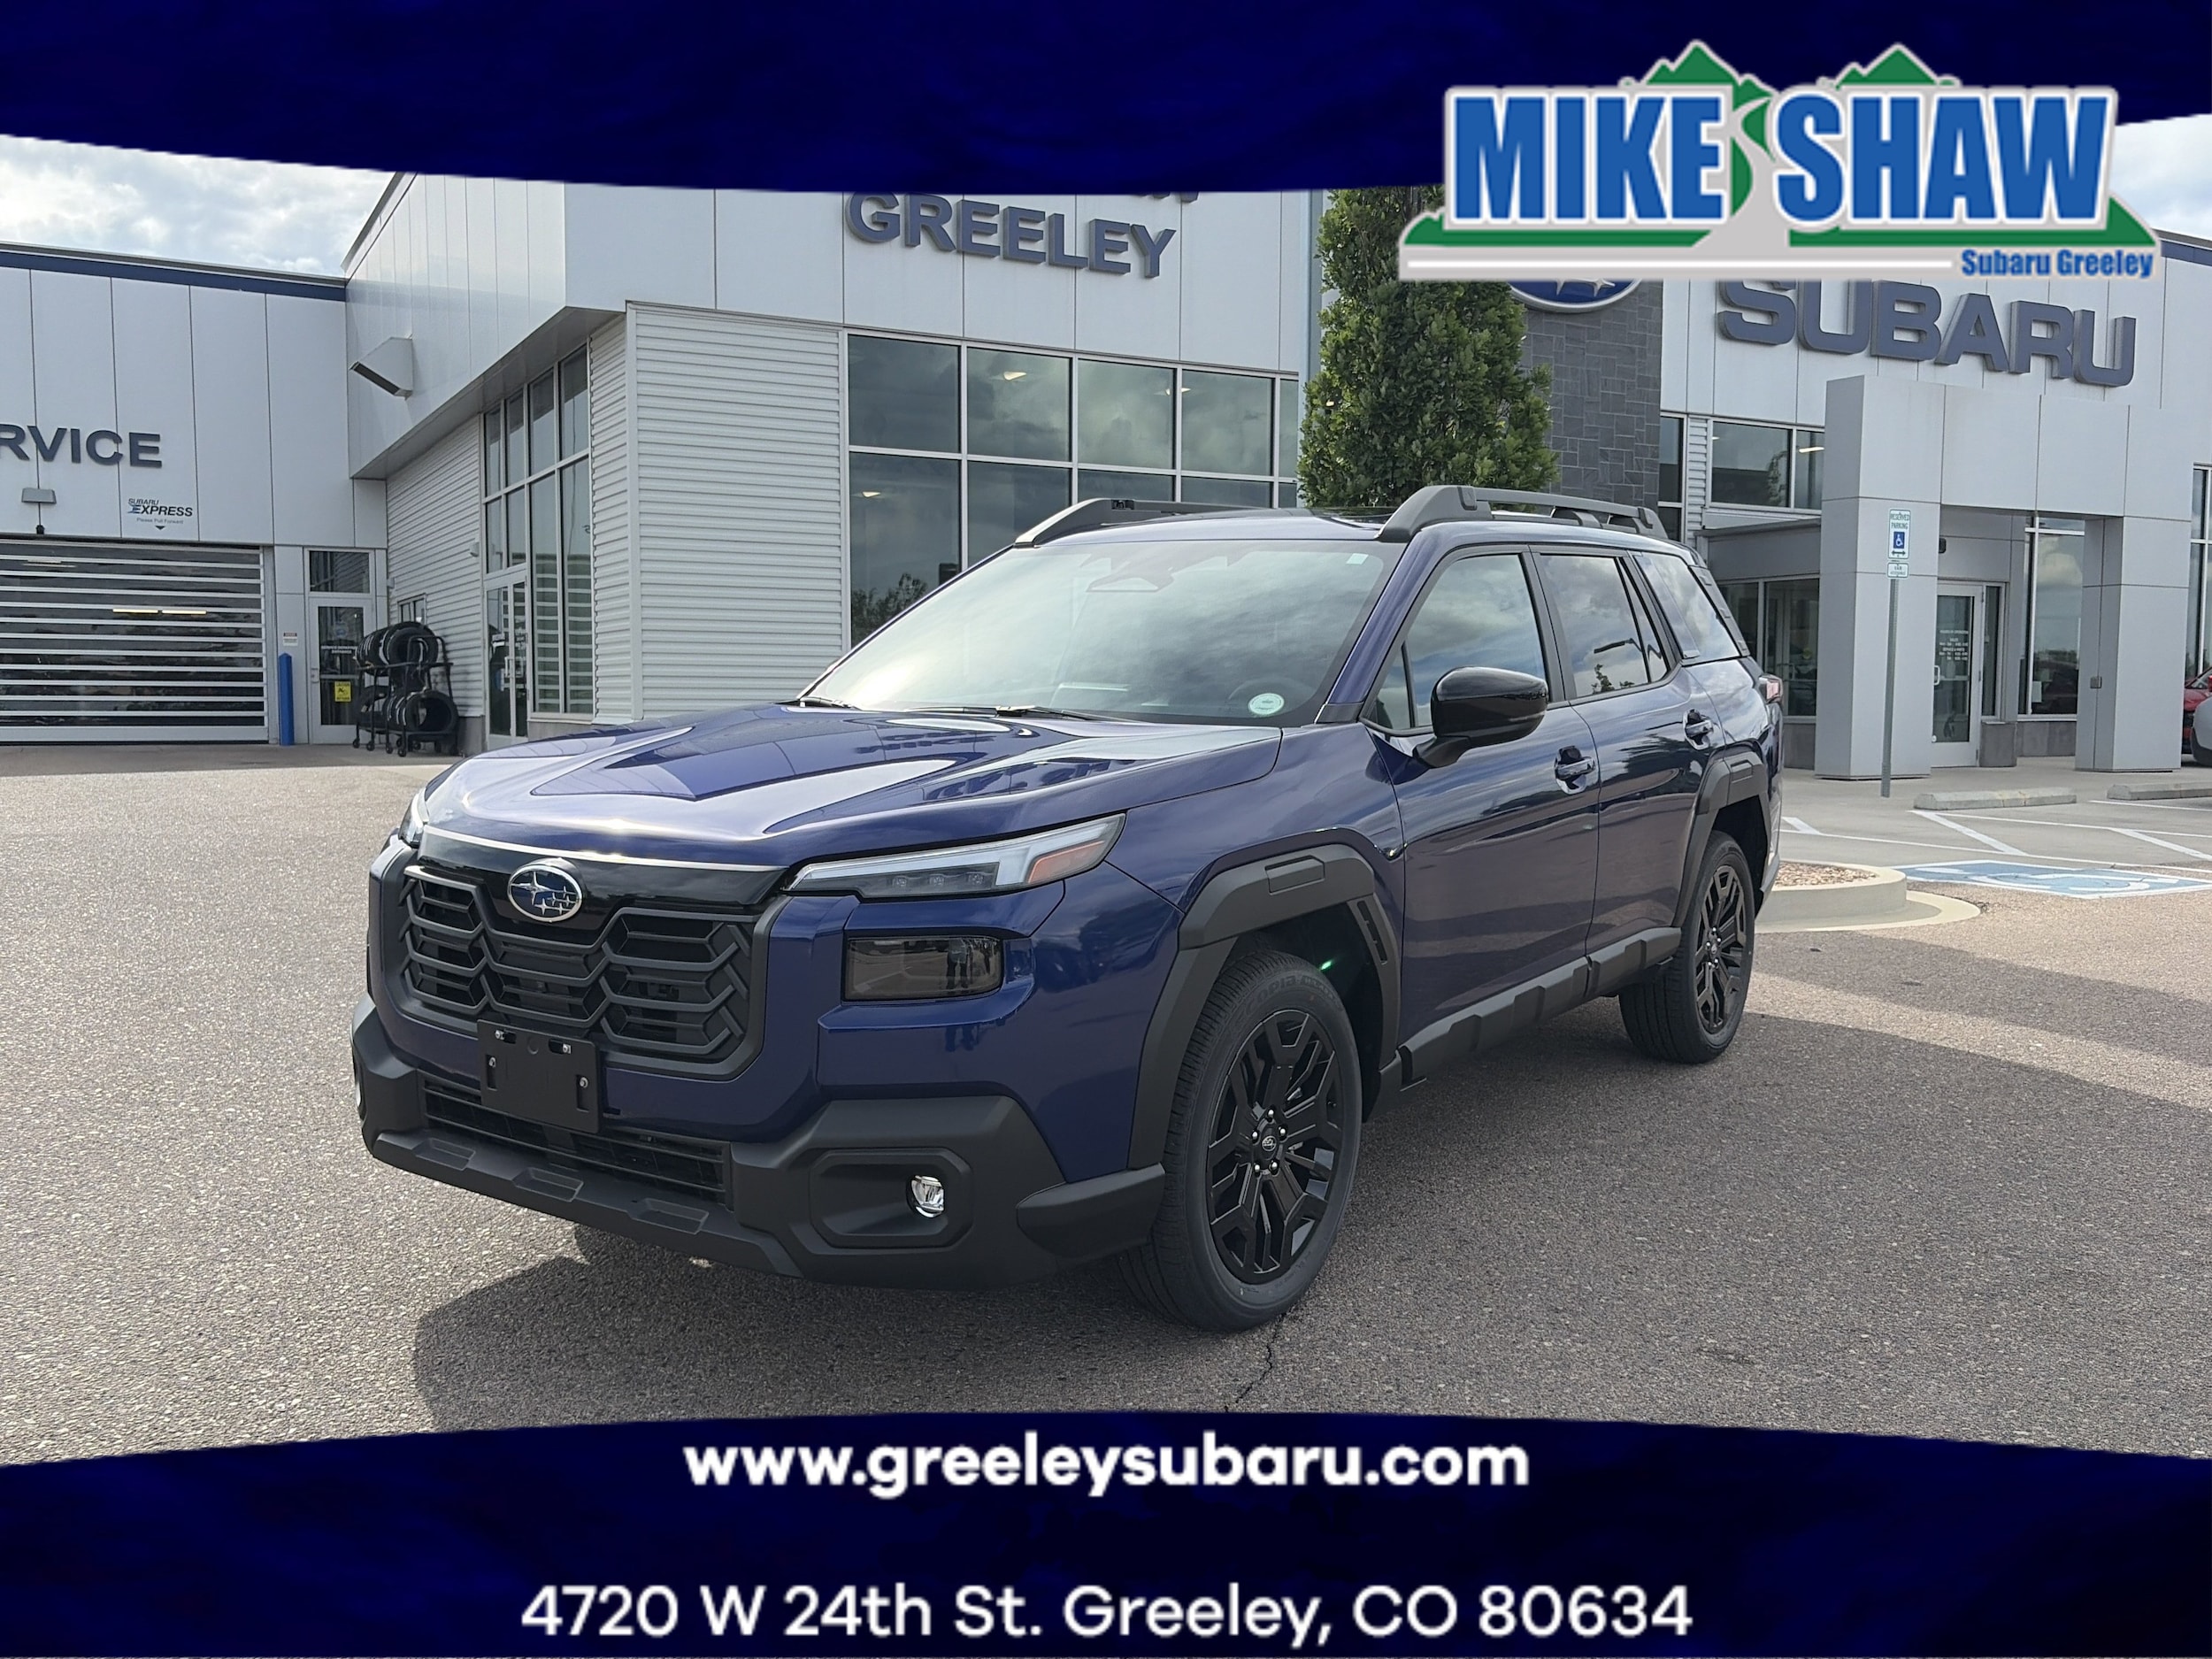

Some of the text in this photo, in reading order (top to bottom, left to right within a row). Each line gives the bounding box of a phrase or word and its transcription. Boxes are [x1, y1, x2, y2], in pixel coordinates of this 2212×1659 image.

[846, 191, 1176, 278] GREELEY
[1717, 278, 2137, 388] SUBARU
[127, 504, 193, 517] EXPRESS
